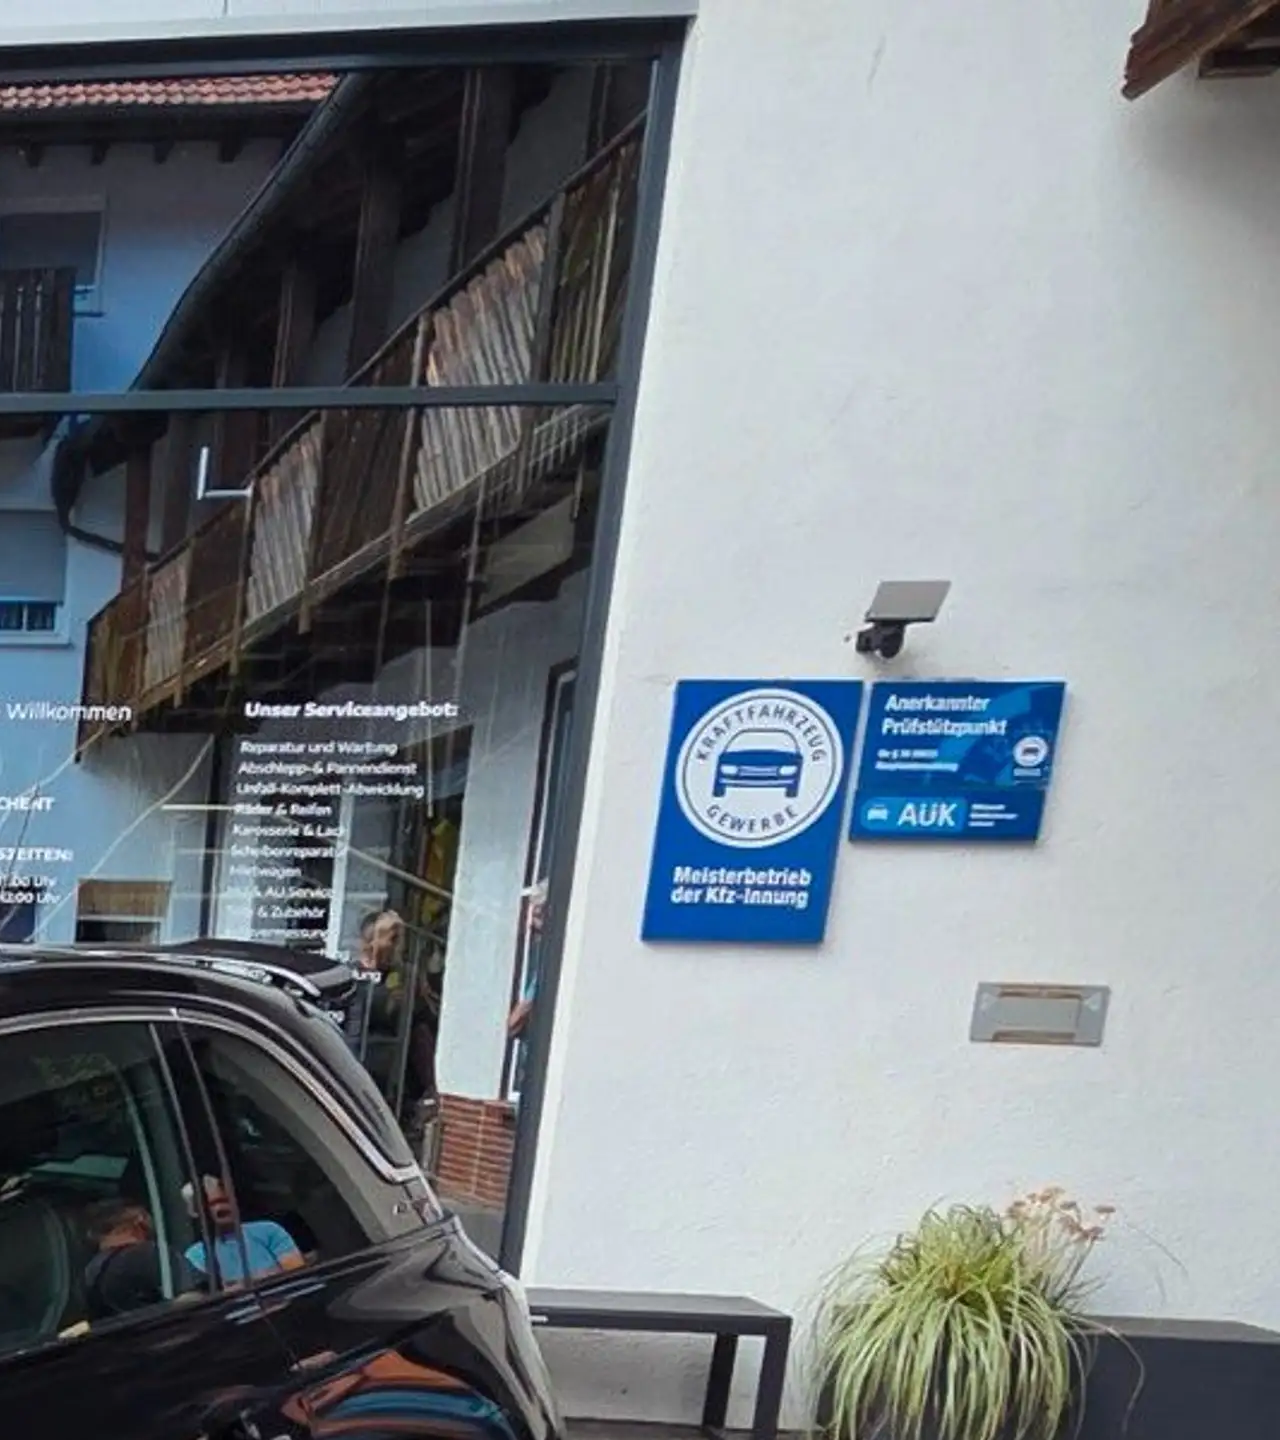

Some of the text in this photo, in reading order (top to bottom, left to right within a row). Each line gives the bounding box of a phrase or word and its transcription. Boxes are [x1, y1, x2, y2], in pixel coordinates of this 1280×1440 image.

[7, 701, 132, 722] Willkommen
[245, 701, 458, 721] Unser Serviceangebot:
[884, 694, 991, 712] Anerkannter
[696, 704, 828, 762] KRAFTFAHRZEUG
[881, 718, 1008, 737] Prüfstützpunkt
[240, 741, 305, 754] Reparatur
[307, 740, 335, 753] und
[706, 803, 800, 834] GEWERBE
[673, 866, 812, 886] Meisterbetrieb
[671, 886, 809, 910] der Kfz-Innung
